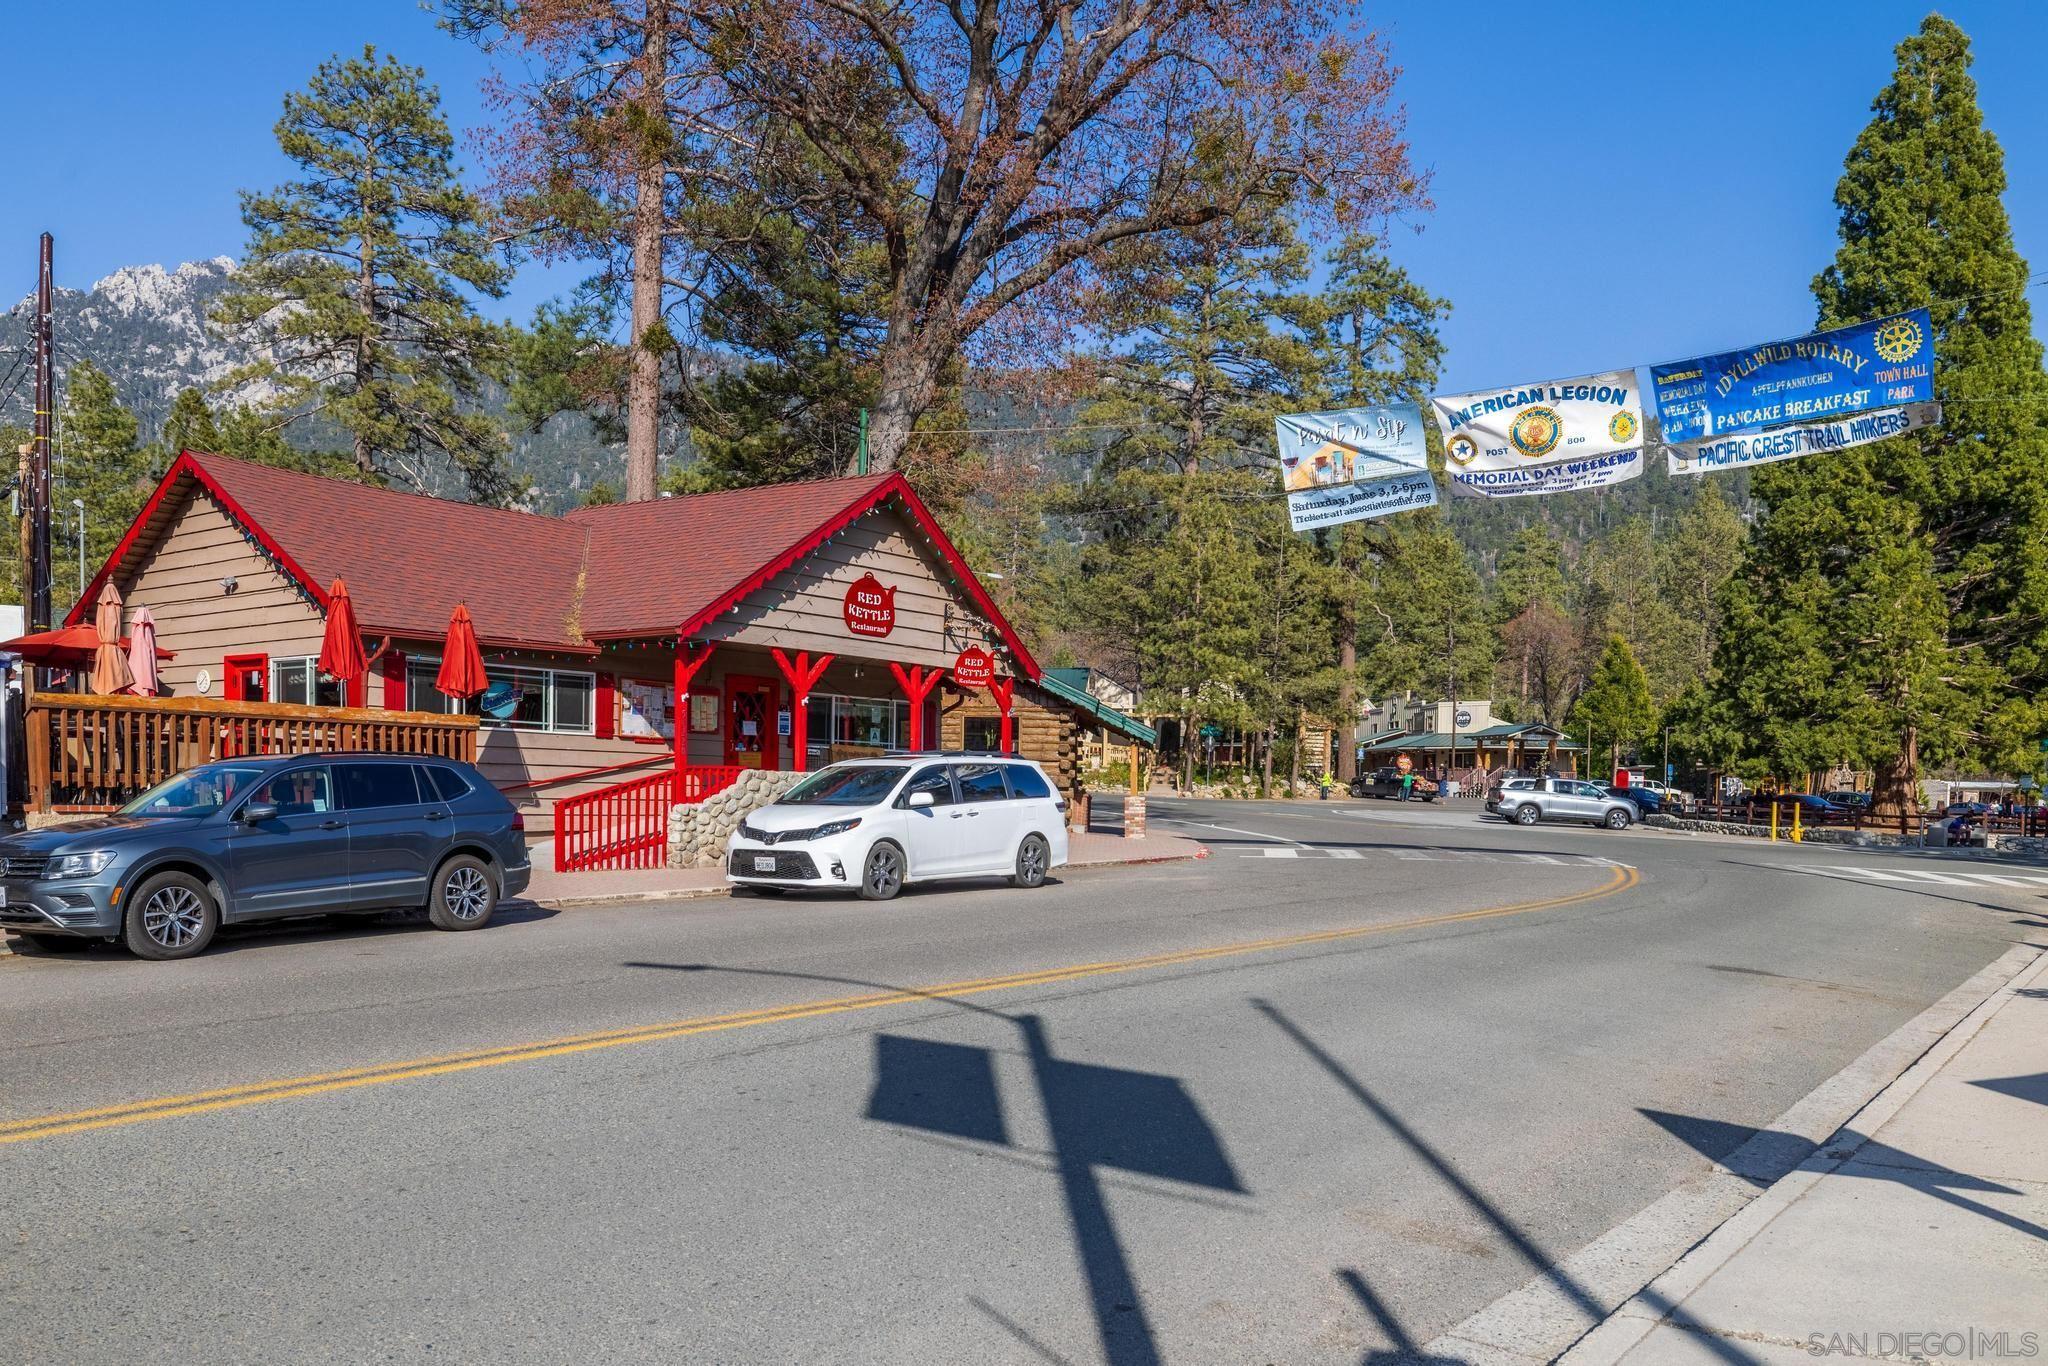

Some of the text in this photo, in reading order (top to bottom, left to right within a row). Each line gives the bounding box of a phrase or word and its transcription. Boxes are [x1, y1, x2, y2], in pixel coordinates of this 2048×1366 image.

[1714, 341, 1870, 398] IDYLLWILD ROTARY
[1874, 363, 1929, 384] TOWN HALL
[1659, 380, 1707, 402] MEMORIAL DAY
[1751, 371, 1833, 397] APFELPFANNKUCHEN
[1887, 385, 1915, 400] PARK
[1447, 387, 1544, 430] AMERICAN
[1550, 385, 1628, 406] LEGION
[1662, 399, 1708, 417] WEEKEND
[1716, 389, 1871, 430] PANCAKE BREAKFAST
[1375, 415, 1408, 445] Sip
[1663, 423, 1670, 434] 8
[1671, 421, 1683, 433] AM
[1486, 436, 1586, 457] POST 800
[1697, 411, 1910, 467] PACIFIC CREST TRAIL HIKERS
[1453, 451, 1638, 485] MEMORIAL DAY WEEKEND
[1292, 497, 1349, 512] Saturday,
[1348, 491, 1377, 505] June
[1391, 481, 1430, 495] 2-6pm
[1487, 487, 1525, 496] Monday
[857, 591, 882, 606] RED
[848, 603, 891, 622] KETTLE
[851, 621, 887, 634] Restaurant
[957, 666, 990, 677] KETTLE
[964, 657, 984, 667] RED
[958, 678, 987, 686] Restaurant
